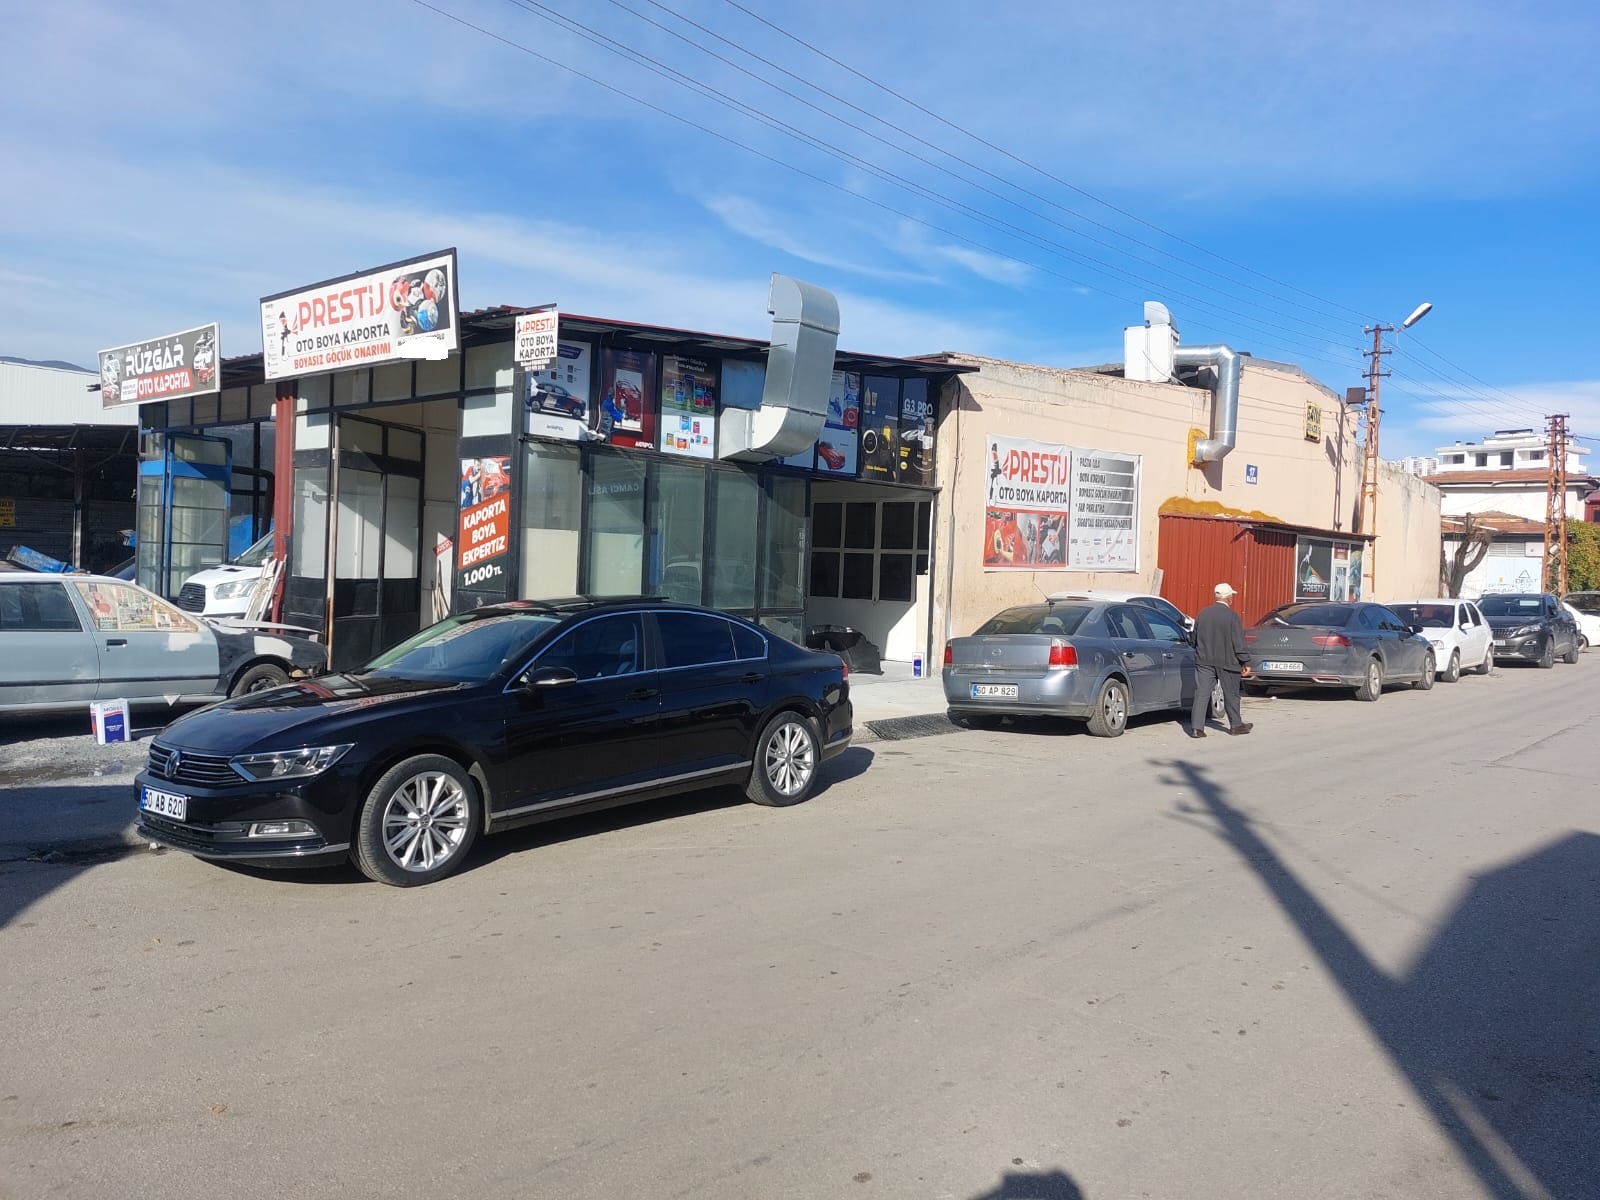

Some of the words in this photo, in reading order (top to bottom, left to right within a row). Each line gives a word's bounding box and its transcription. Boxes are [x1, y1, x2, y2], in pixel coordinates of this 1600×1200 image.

[295, 337, 314, 353] OTO
[316, 333, 341, 349] BOYA
[343, 322, 390, 343] KAPORTA
[520, 337, 535, 348] OTO
[536, 334, 554, 346] BOYA
[125, 342, 185, 377] RÜZGAR
[293, 353, 324, 370] BOYASIZ
[325, 347, 352, 366] GÖÇÜK
[354, 342, 391, 359] ONARIMI
[519, 346, 556, 359] KAPORTA
[138, 378, 154, 396] OTO
[154, 371, 191, 393] KAPORTA
[904, 397, 915, 413] G3
[917, 401, 934, 416] PRO
[999, 486, 1015, 501] OTO
[1016, 488, 1035, 502] BOYA
[1036, 490, 1068, 505] KAPORTA
[463, 498, 507, 531] KAPORTA
[471, 521, 497, 545] BOYA
[462, 535, 506, 567] EKPERTİZ
[463, 564, 494, 587] 1.000
[493, 565, 503, 577] TL
[988, 686, 999, 696] AP
[1000, 686, 1016, 697] 829
[155, 793, 166, 812] AB
[167, 796, 183, 817] 620
